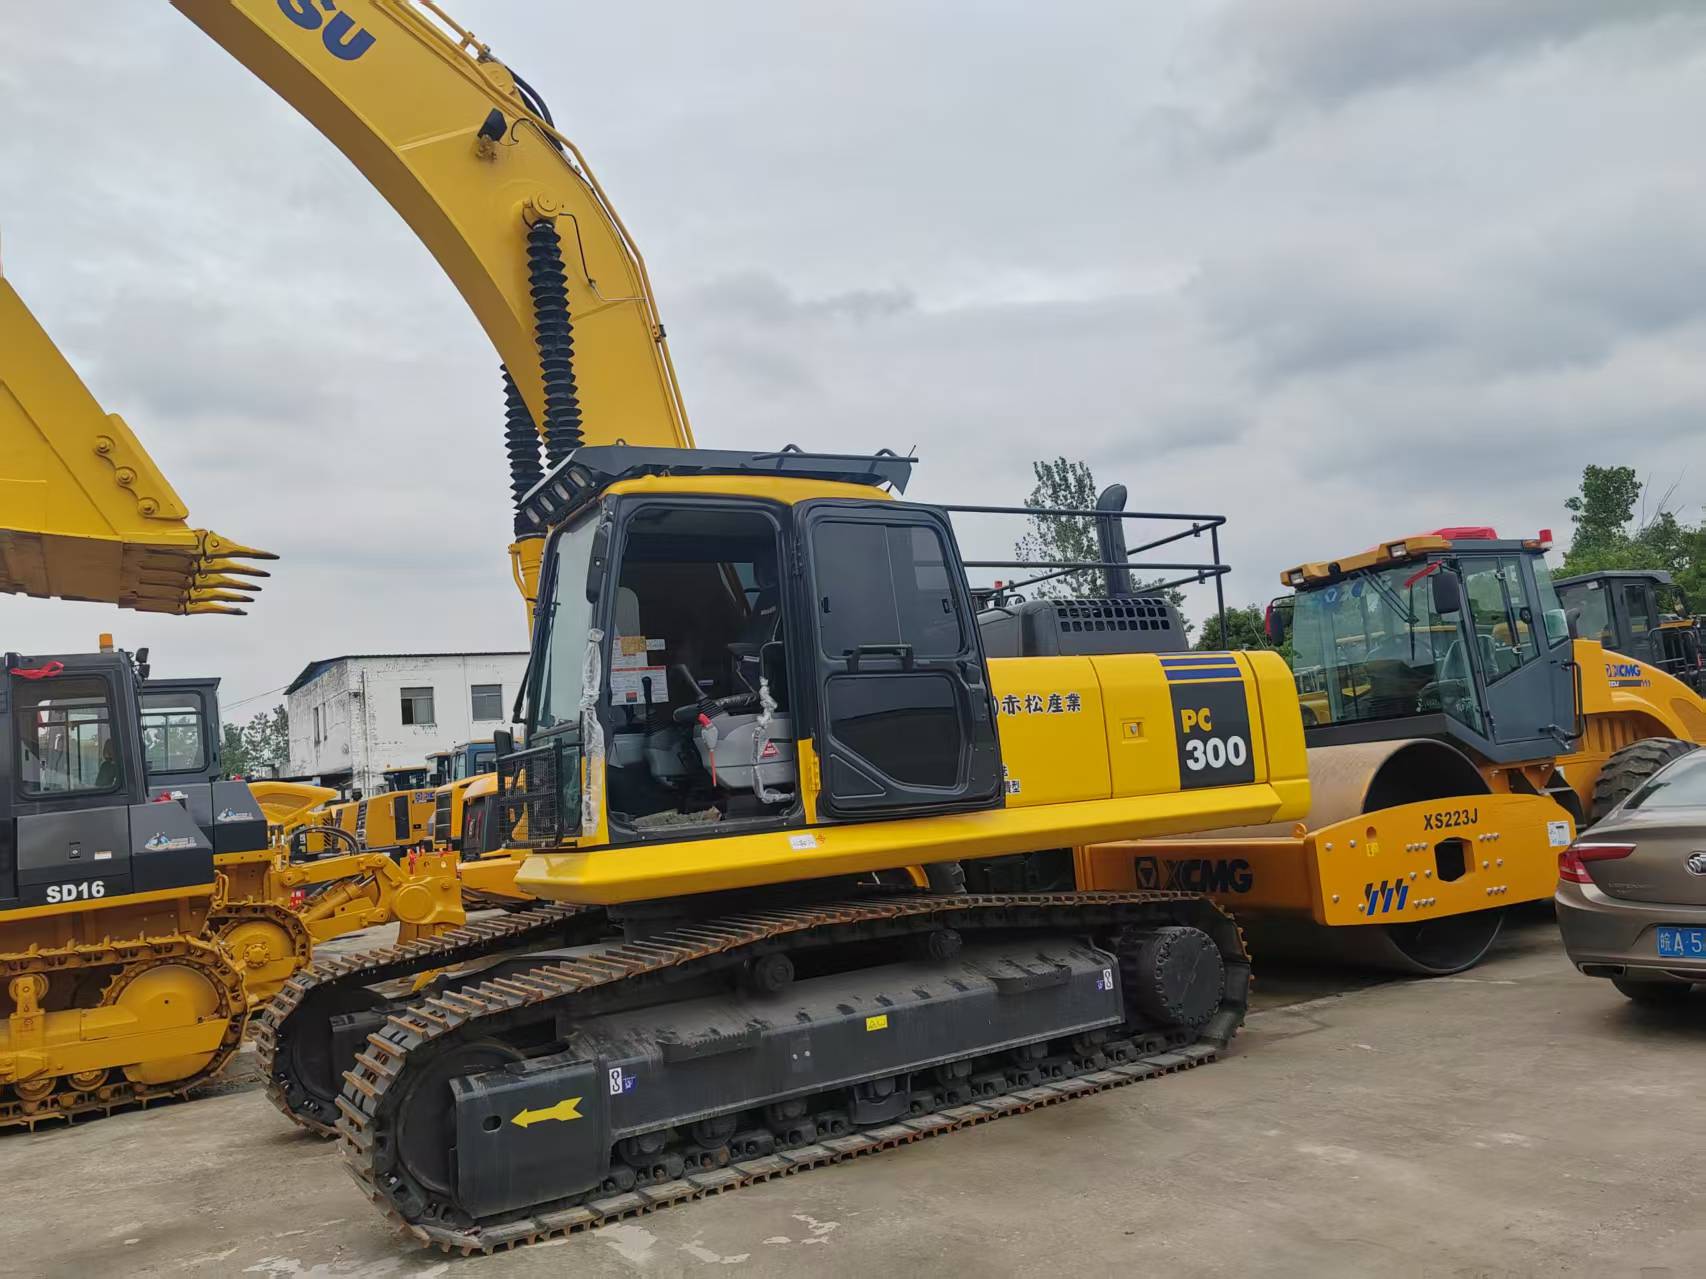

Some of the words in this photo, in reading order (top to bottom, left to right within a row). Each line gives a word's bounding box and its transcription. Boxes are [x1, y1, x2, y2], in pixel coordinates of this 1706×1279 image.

[1181, 707, 1212, 733] PC
[1185, 735, 1247, 771] 300
[1423, 807, 1479, 831] XS223J
[1162, 858, 1254, 894] XCMG
[46, 880, 105, 903] SD16
